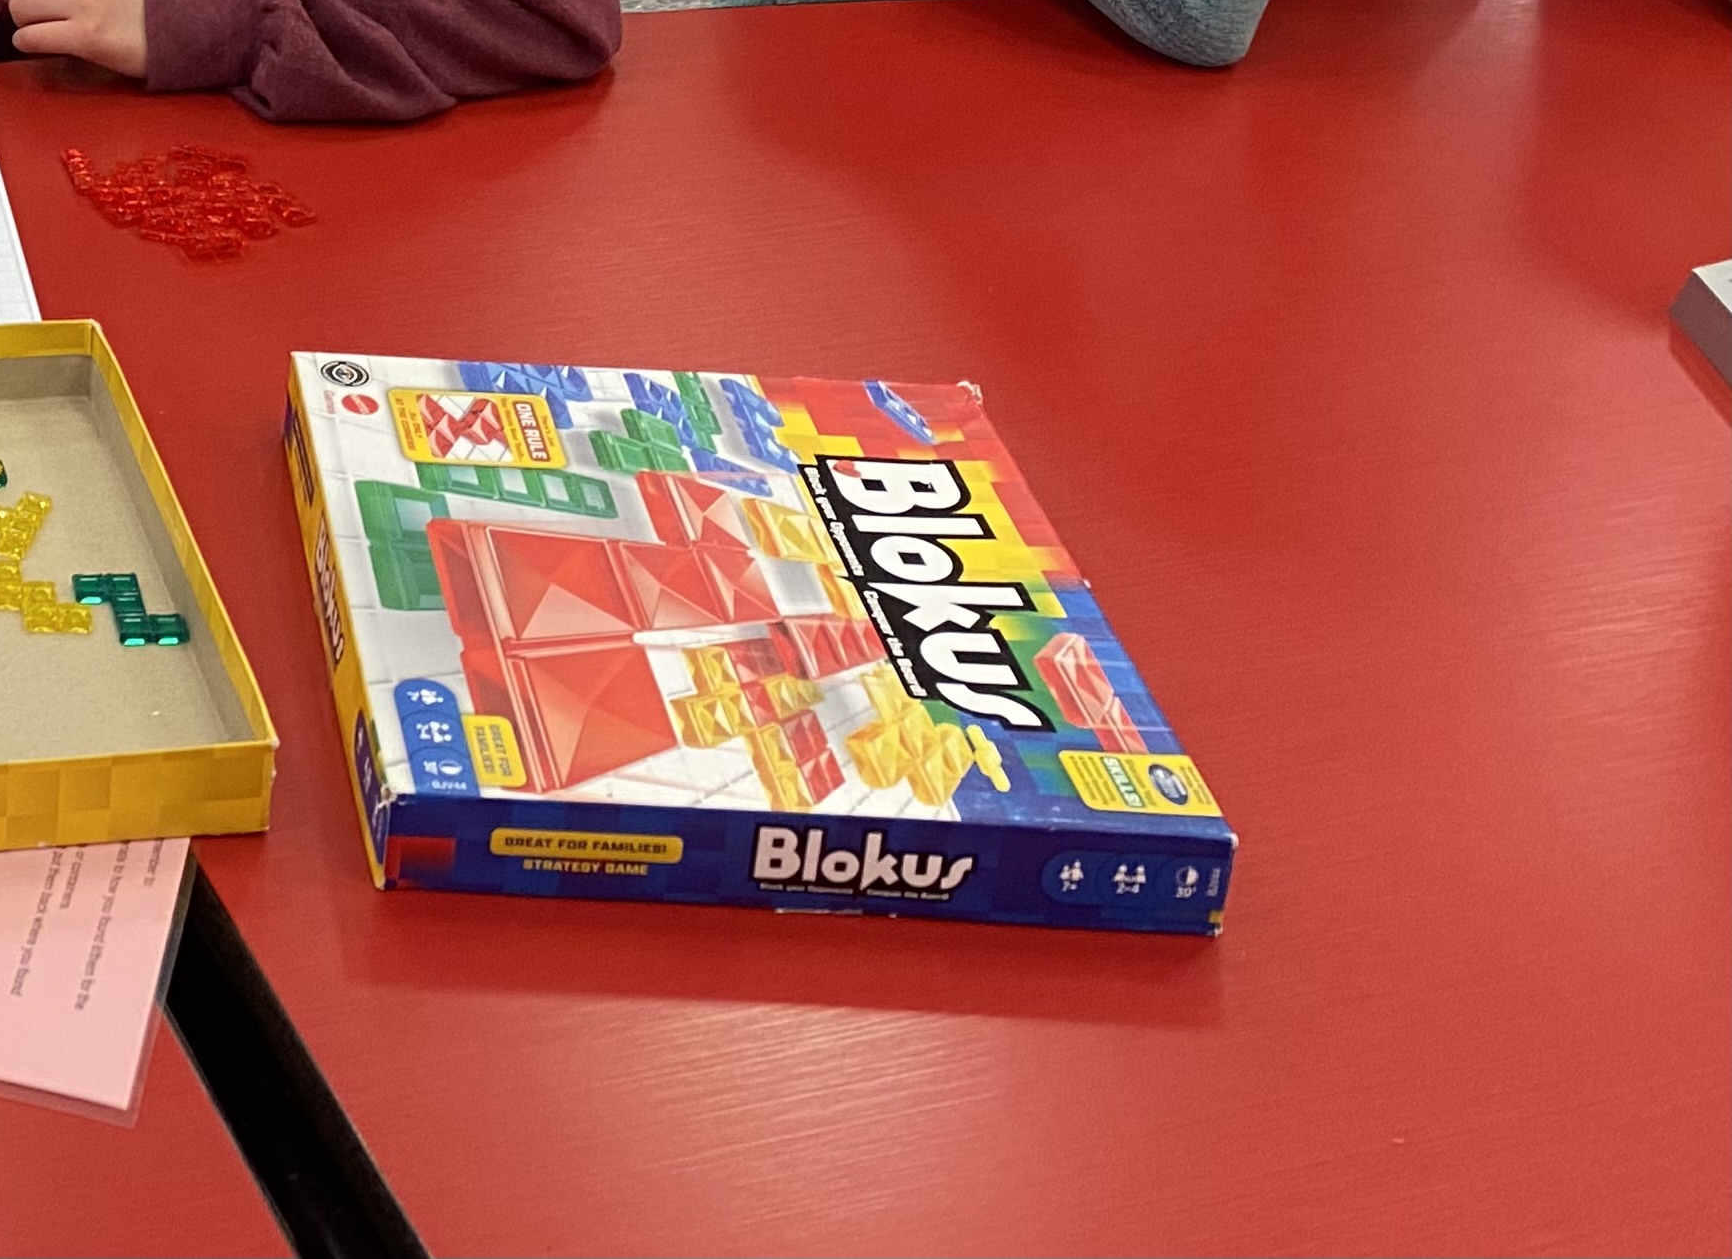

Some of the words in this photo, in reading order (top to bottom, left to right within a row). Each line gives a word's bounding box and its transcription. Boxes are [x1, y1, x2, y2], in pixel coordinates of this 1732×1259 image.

[514, 403, 537, 426] ONE
[523, 429, 547, 458] RULE
[825, 459, 1045, 729] Blokus
[504, 835, 554, 851] GREAT
[557, 837, 589, 851] FOR
[591, 840, 668, 855] FAMILIES!
[752, 825, 974, 891] Blokus
[522, 858, 602, 874] STRATEGY
[605, 863, 649, 876] GAME
